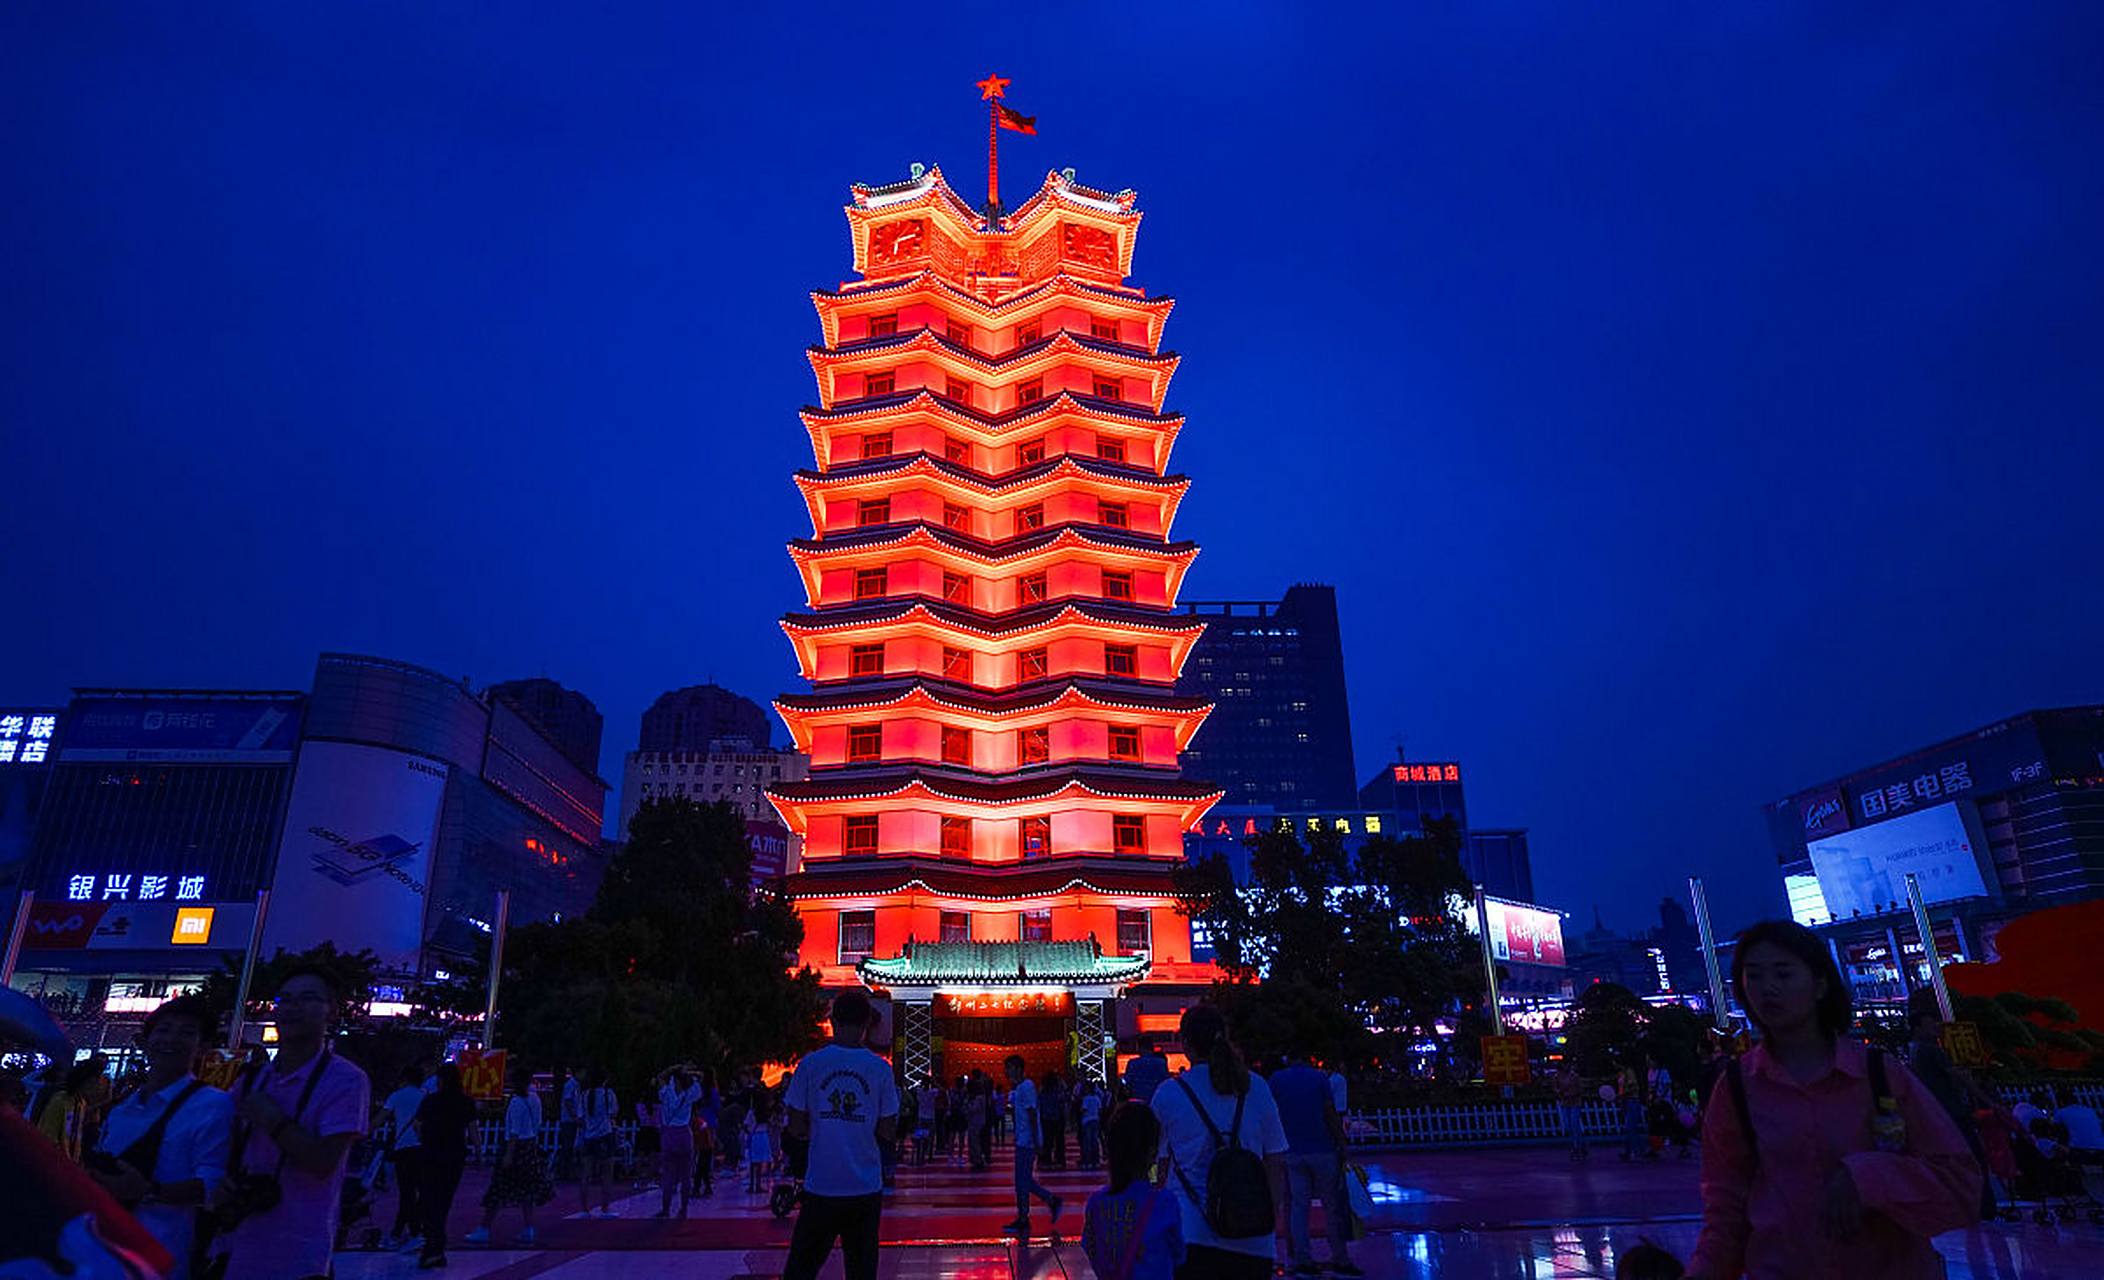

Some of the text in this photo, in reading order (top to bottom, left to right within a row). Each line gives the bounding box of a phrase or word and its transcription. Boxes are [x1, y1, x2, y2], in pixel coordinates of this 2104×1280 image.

[0, 715, 56, 738] 华联
[1393, 764, 1460, 782] 商城酒店
[1860, 760, 1974, 818] 国美电器
[68, 874, 205, 900] 银兴影城
[462, 1057, 500, 1095] 心
